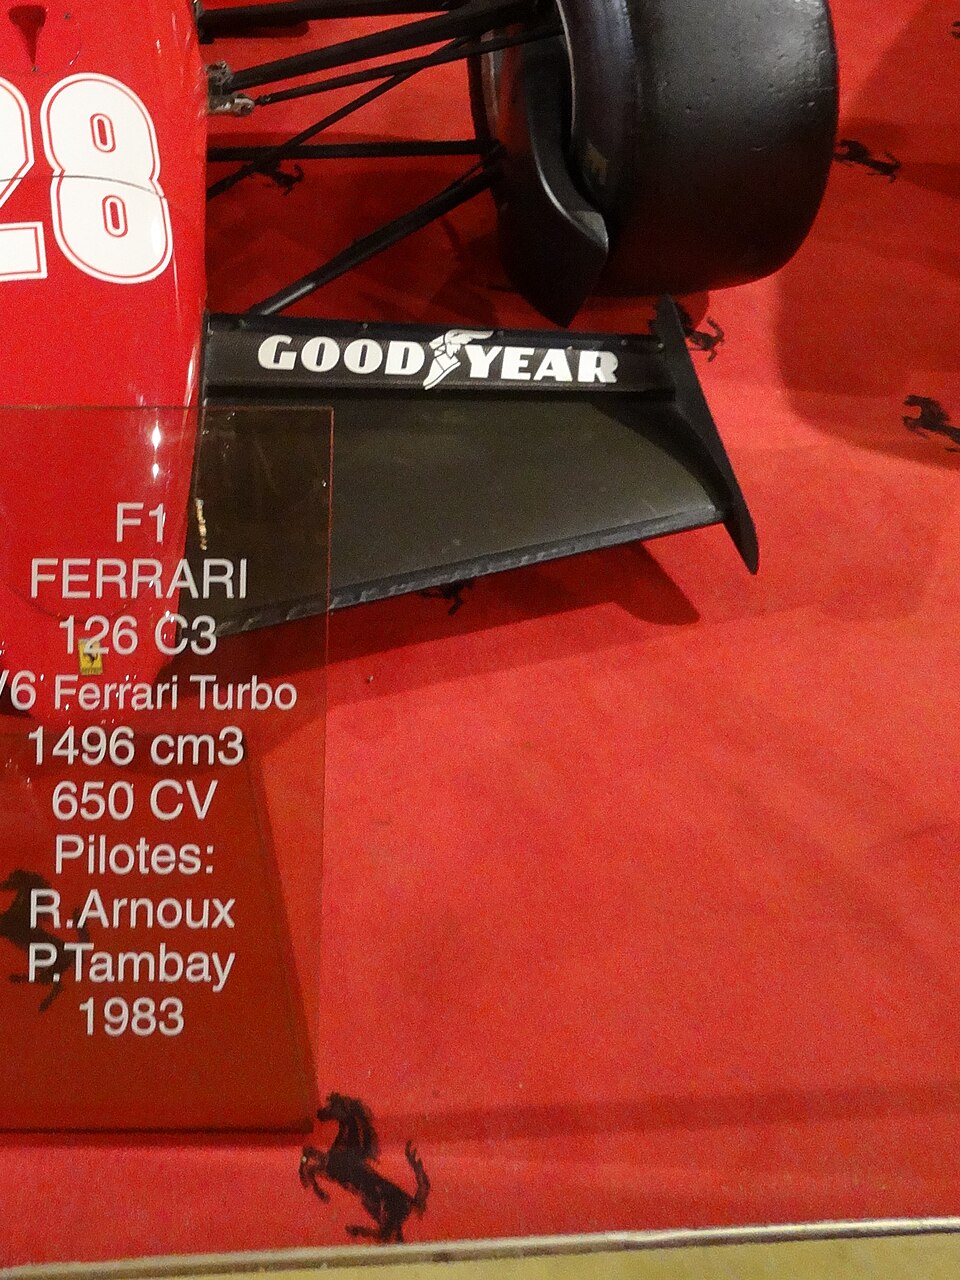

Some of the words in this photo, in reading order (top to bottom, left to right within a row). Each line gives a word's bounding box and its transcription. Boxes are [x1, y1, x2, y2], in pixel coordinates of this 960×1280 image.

[257, 332, 620, 387] GOODYEAR
[115, 502, 166, 542] F1
[30, 558, 247, 598] FERRARI
[60, 616, 138, 655] 126
[154, 615, 217, 655] C3
[54, 675, 179, 710] Ferrari
[190, 675, 298, 711] Turbo
[28, 727, 135, 766] 1496
[150, 726, 245, 766] cm3
[52, 781, 134, 821] 650
[149, 780, 219, 821] CV
[55, 834, 215, 875] Pilotes:
[29, 889, 236, 929] R.Arnoux
[27, 943, 236, 991] P.Tambay
[79, 997, 185, 1037] 1983
